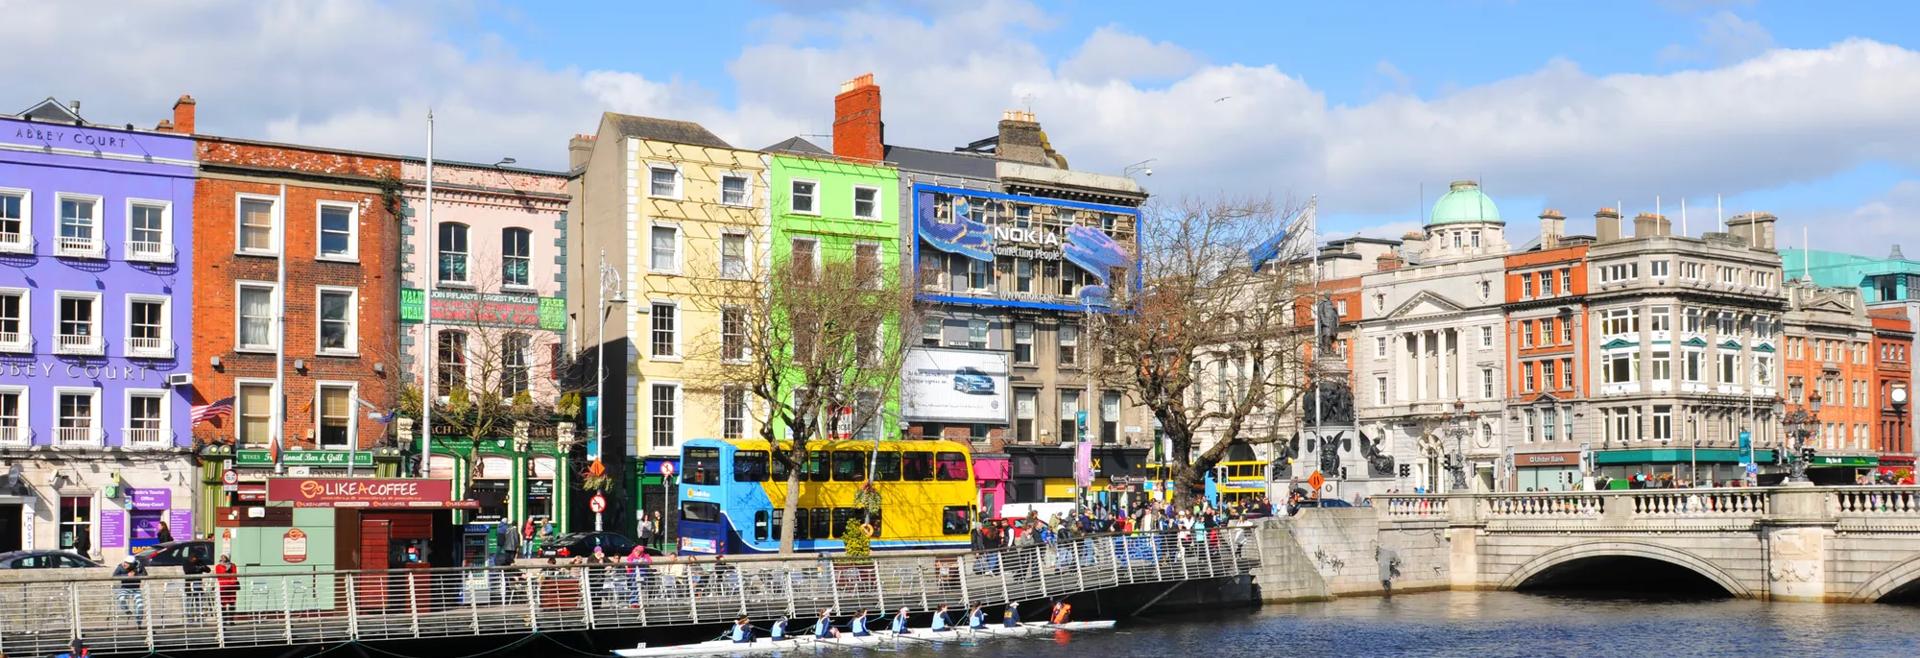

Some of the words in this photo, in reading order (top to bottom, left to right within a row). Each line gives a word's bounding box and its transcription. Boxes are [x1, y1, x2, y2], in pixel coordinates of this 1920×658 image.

[16, 128, 63, 141] ABBEY
[73, 133, 126, 148] COURT
[994, 226, 1058, 246] NOKIA
[993, 246, 1034, 260] Connecting
[1035, 249, 1060, 262] People
[402, 290, 425, 304] VALU
[402, 306, 425, 319] DEAL
[67, 364, 148, 381] COURT
[304, 453, 319, 462] Bar
[328, 454, 344, 465] Grill
